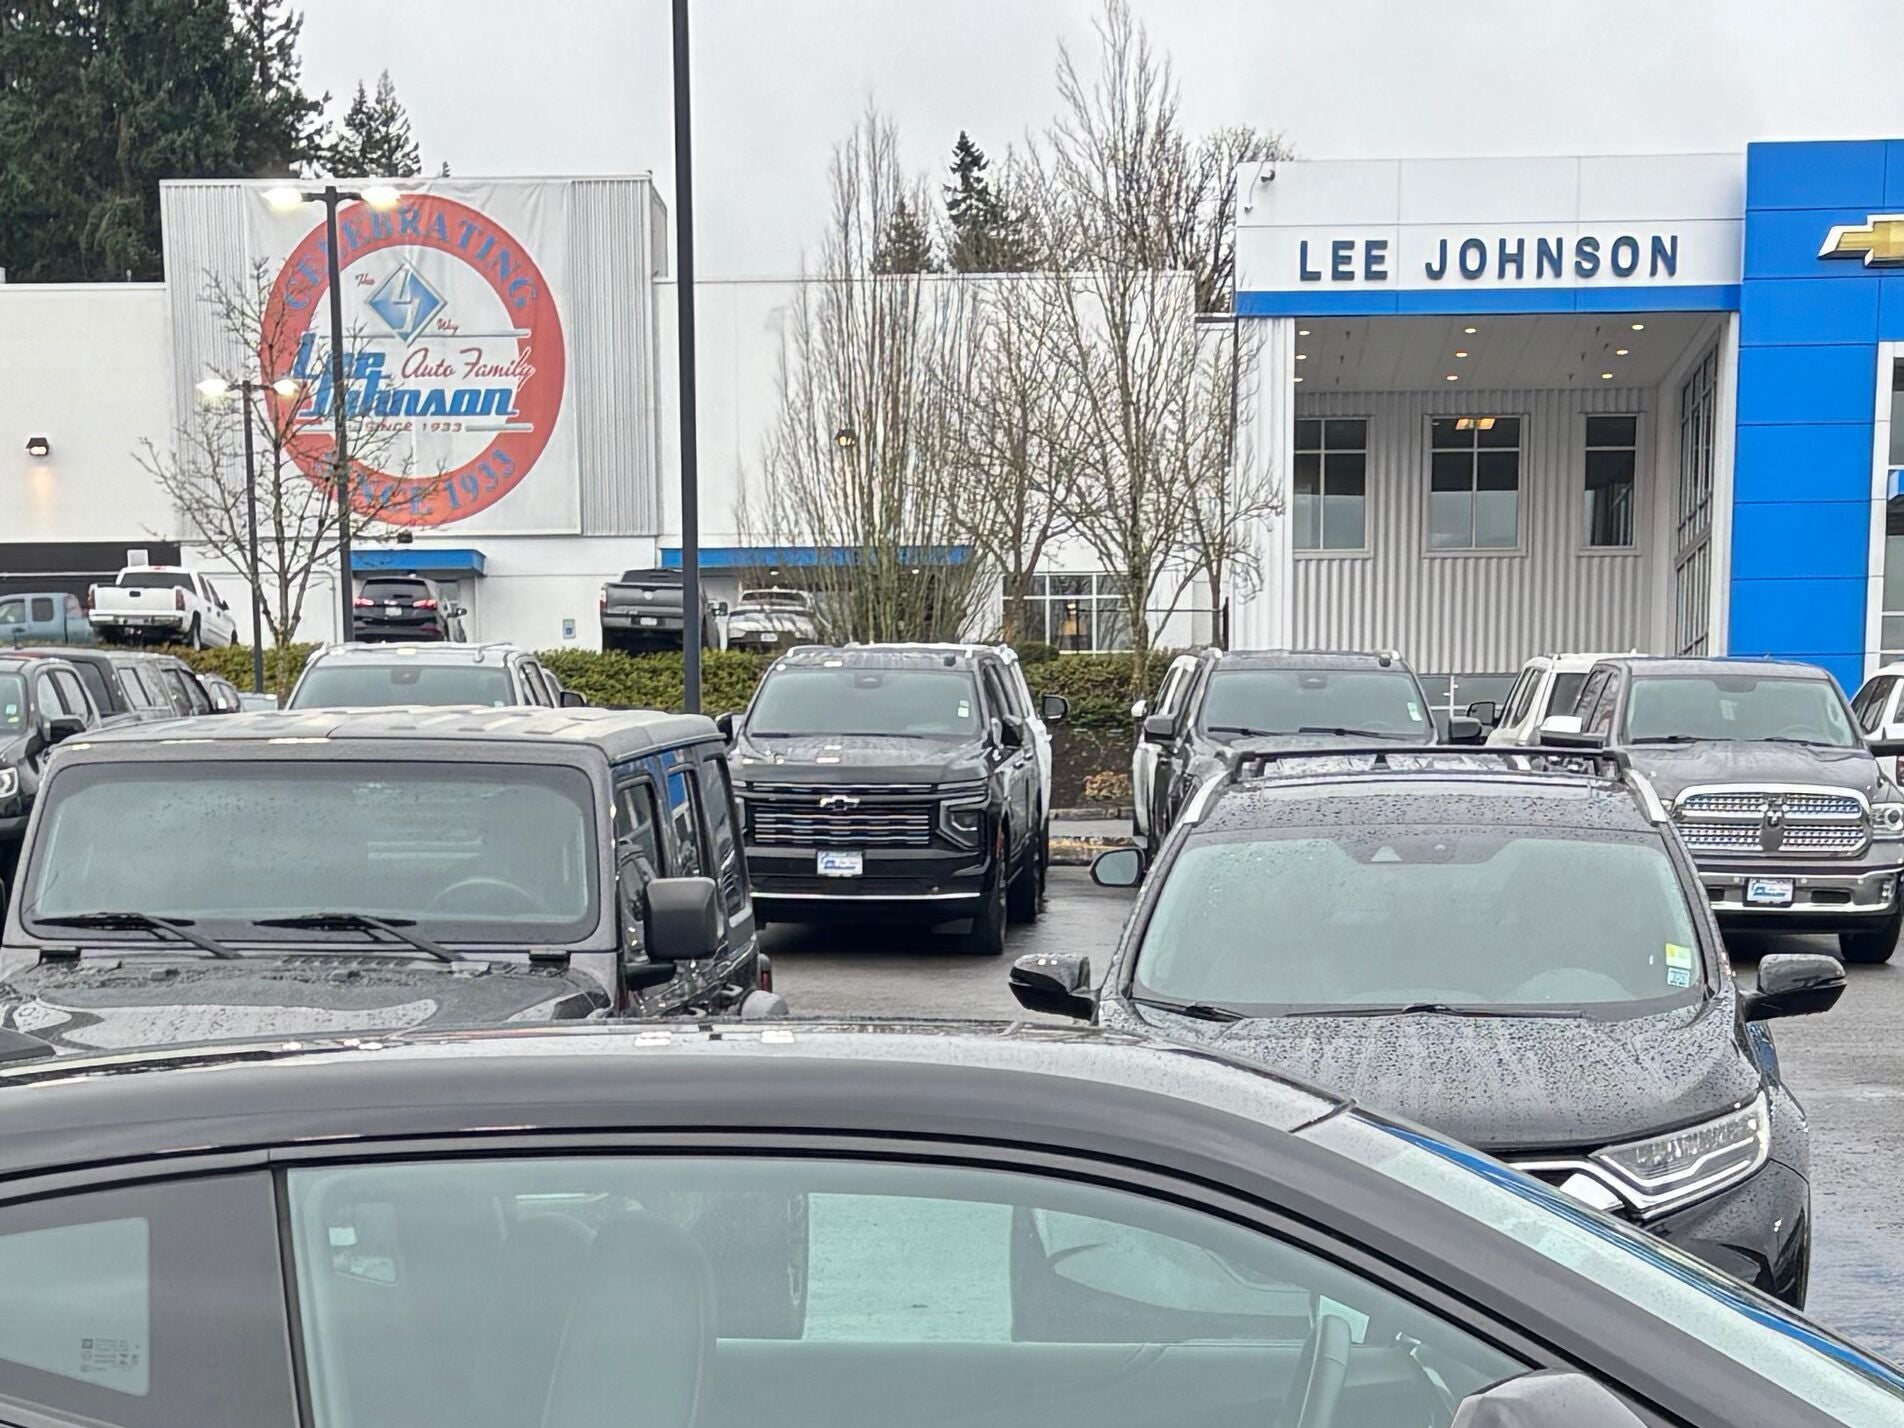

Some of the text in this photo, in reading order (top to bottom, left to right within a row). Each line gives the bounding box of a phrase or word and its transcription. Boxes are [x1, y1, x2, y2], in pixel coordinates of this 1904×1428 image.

[1299, 235, 1678, 281] LEE JOHNSON
[400, 345, 536, 391] Auto Family
[422, 421, 463, 433] 1933
[443, 448, 515, 509] 1933
